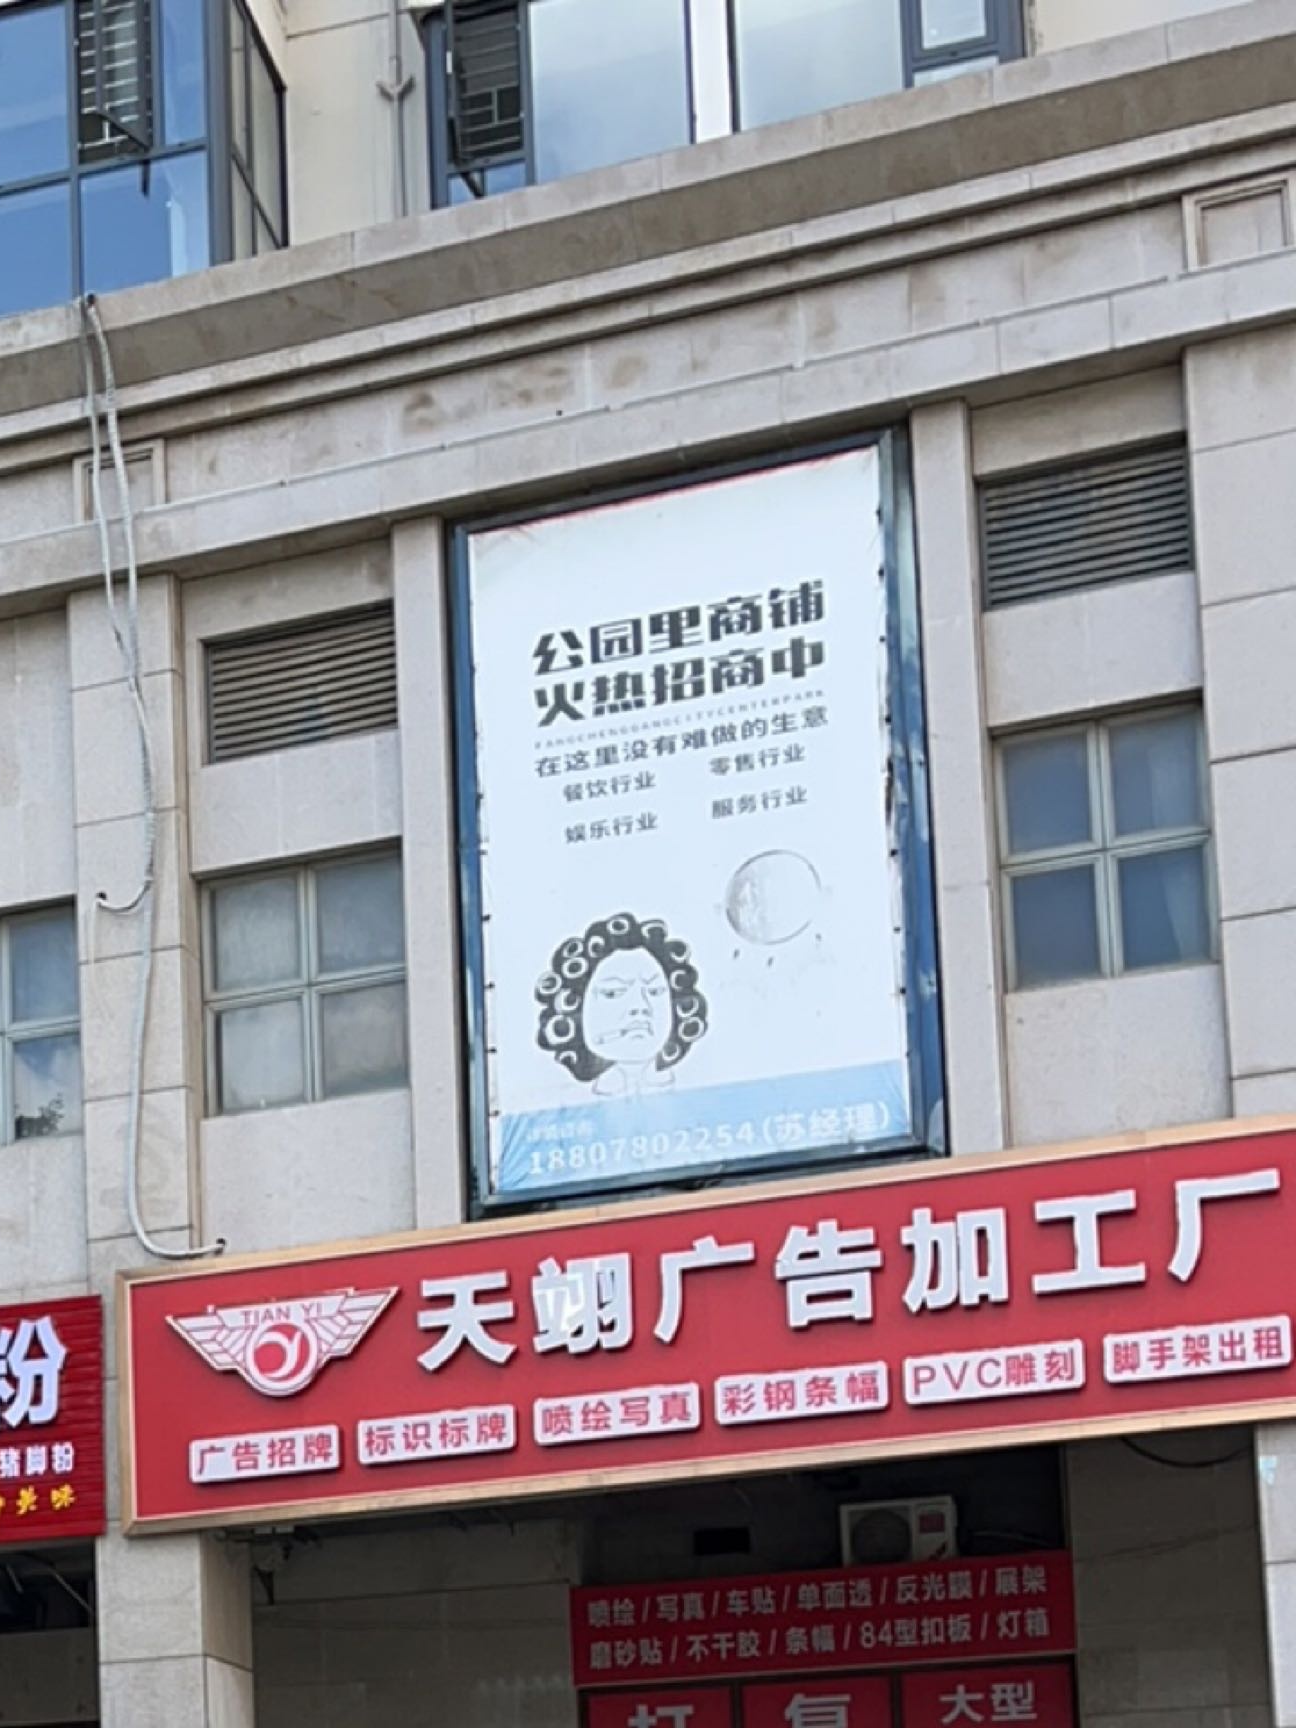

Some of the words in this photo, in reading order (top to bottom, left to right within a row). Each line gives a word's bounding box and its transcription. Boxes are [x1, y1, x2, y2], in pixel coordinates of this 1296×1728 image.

[531, 579, 825, 676] 公园里商铺
[533, 636, 825, 728] 火热招商中
[534, 704, 829, 778] 在这里没有难做的生意
[563, 771, 656, 802] 餐饮行业
[709, 744, 806, 776] 零售行业
[564, 812, 658, 844] 娱乐行业
[711, 785, 808, 819] 服务行业
[416, 1168, 1281, 1372] 天翊广告加工厂
[240, 1307, 291, 1328] TIAN
[302, 1302, 323, 1321] YI
[197, 1431, 334, 1476] 广告招牌
[363, 1411, 509, 1459] 标识标牌
[540, 1390, 694, 1437] 喷绘写真
[721, 1369, 881, 1417] 彩钢条幅
[911, 1347, 1077, 1397] PVC雕刻
[1111, 1325, 1285, 1376] 脚手架出租
[939, 1681, 1039, 1725] 大型
